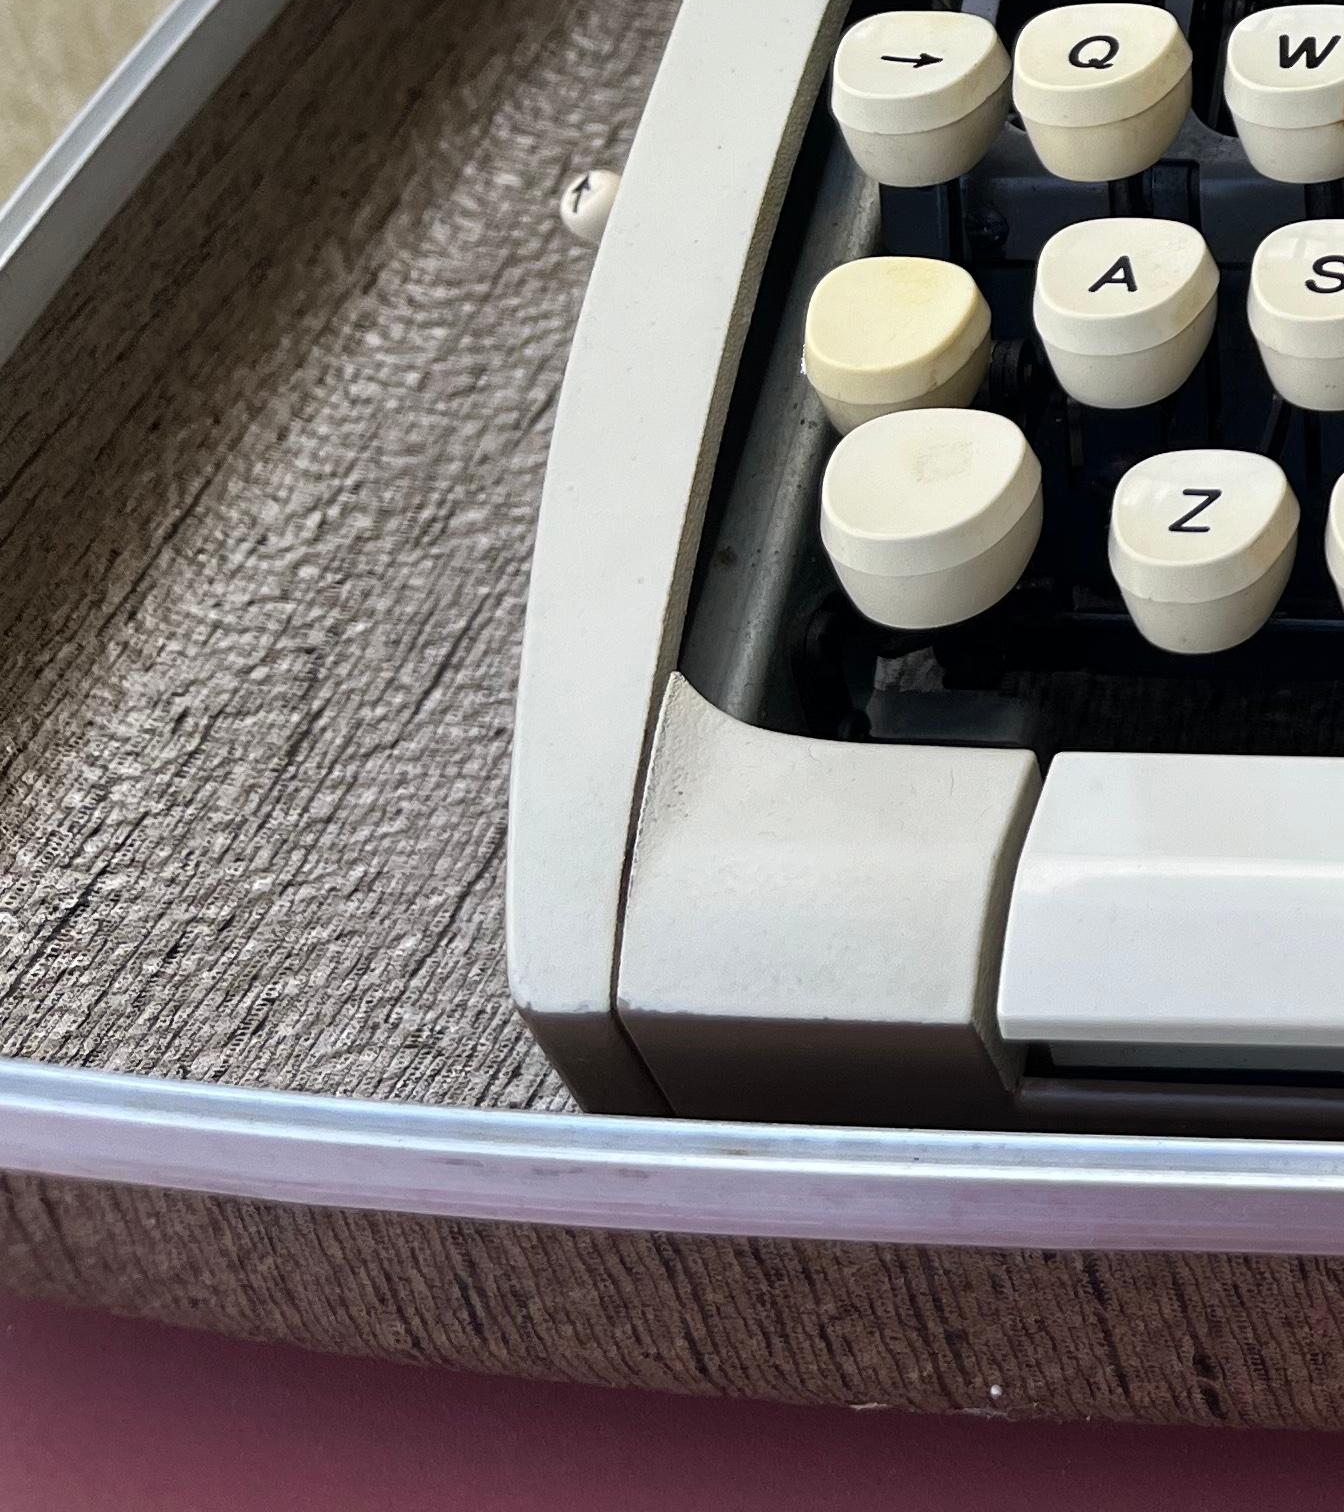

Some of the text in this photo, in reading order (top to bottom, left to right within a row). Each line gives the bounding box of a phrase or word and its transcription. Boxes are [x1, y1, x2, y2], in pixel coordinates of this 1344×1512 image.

[1068, 35, 1120, 70] Q
[1278, 34, 1342, 70] W
[1088, 255, 1138, 293] A
[1168, 488, 1222, 533] Z
